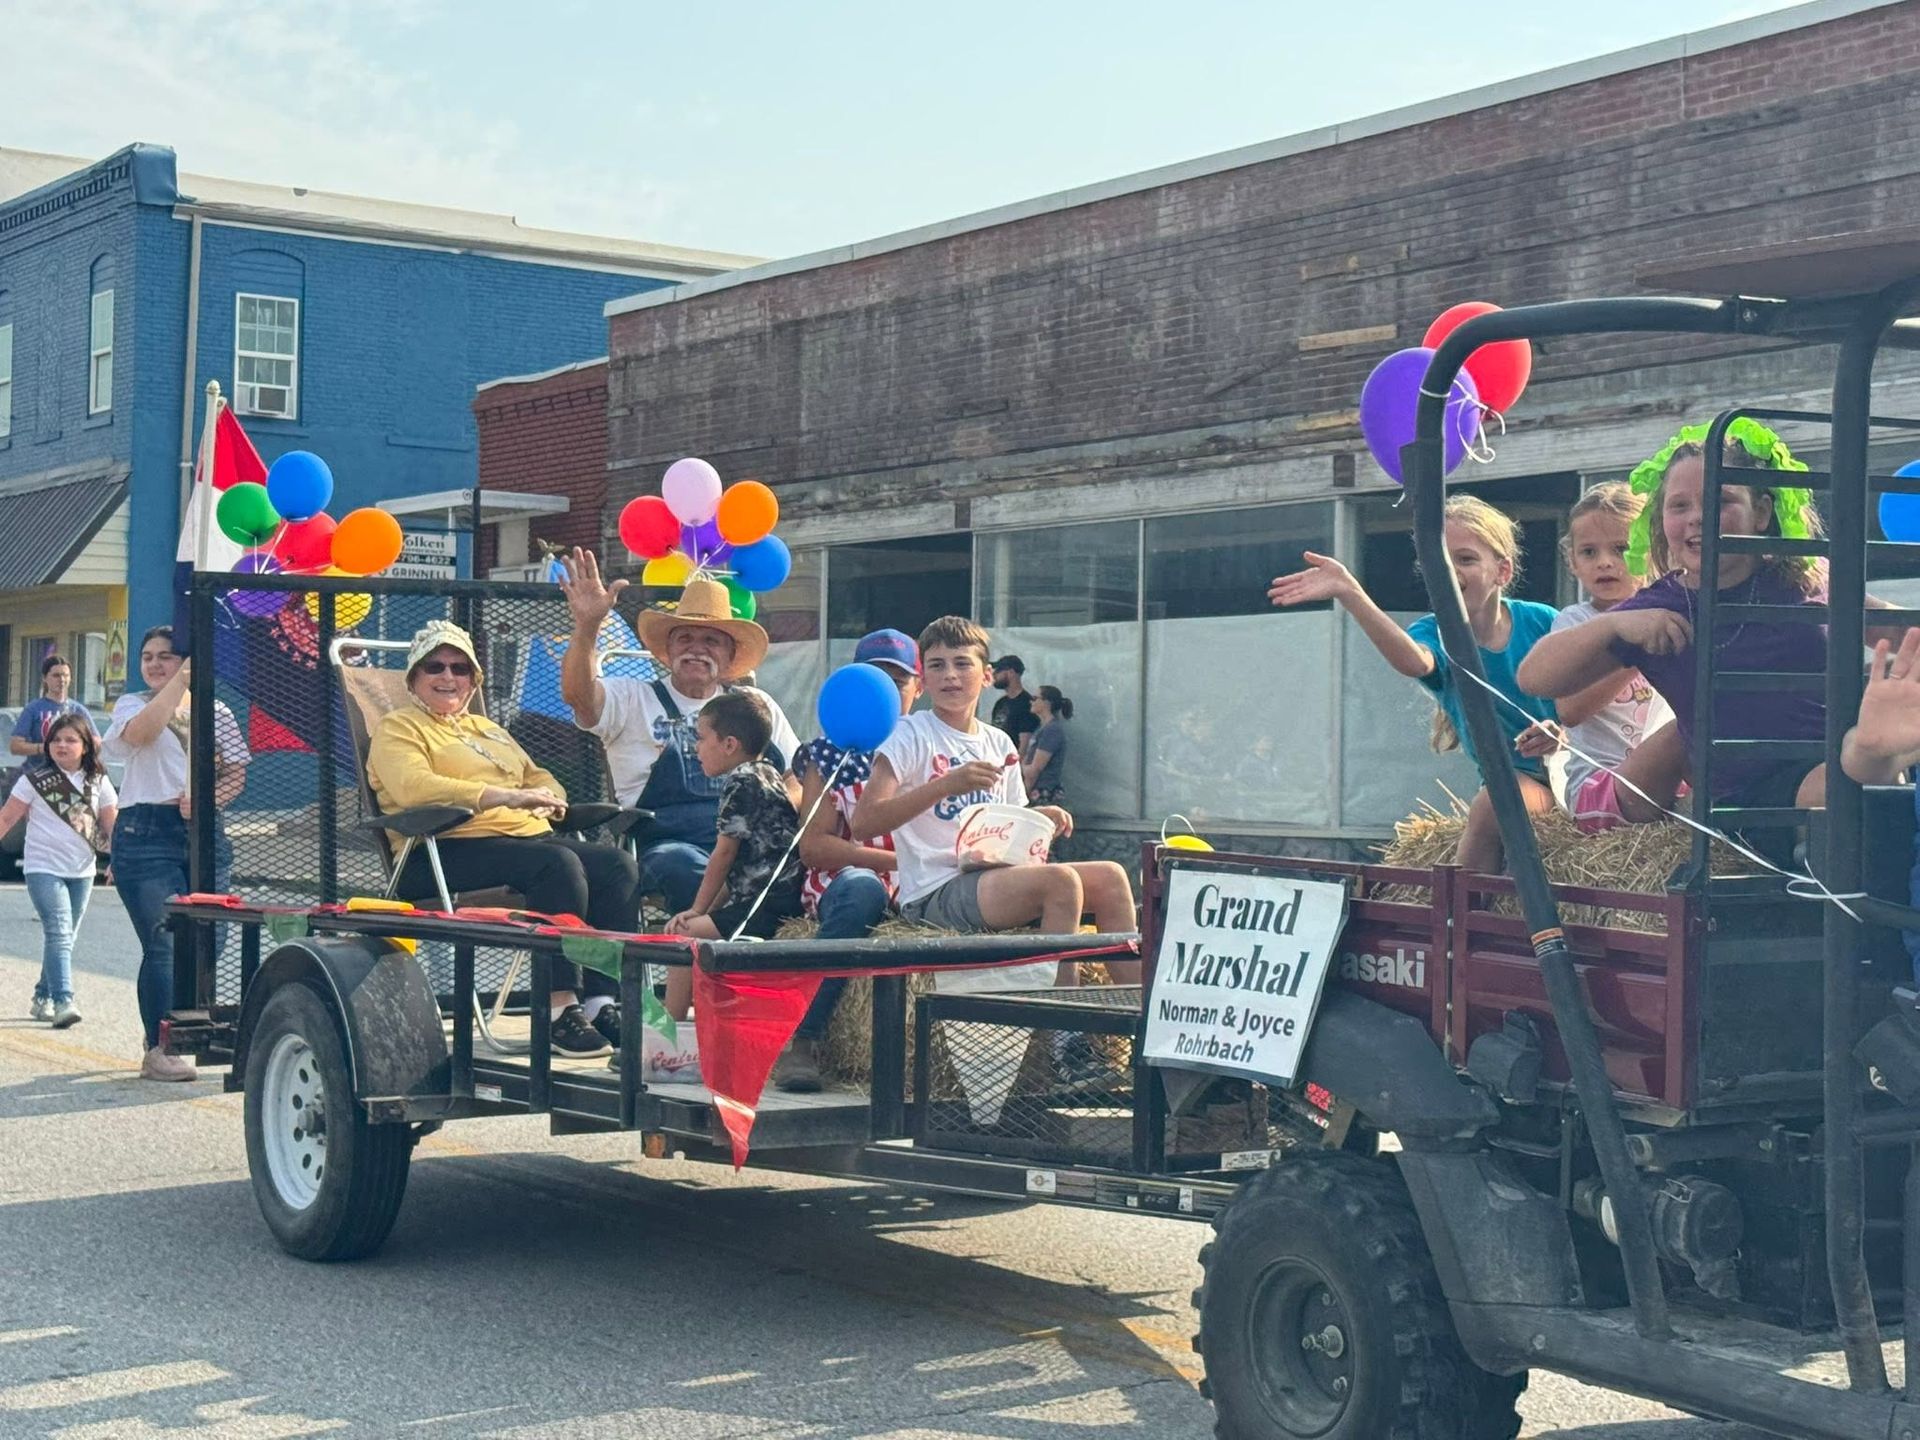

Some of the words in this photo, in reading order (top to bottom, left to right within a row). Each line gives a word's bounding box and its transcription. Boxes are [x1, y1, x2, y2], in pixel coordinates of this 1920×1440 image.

[404, 535, 445, 549] olken
[391, 567, 447, 580] GRINNELL
[1193, 884, 1304, 936] Grand
[1166, 941, 1310, 998] Marshal
[1342, 948, 1425, 988] asaki
[1159, 999, 1218, 1025] Norman
[1222, 1005, 1236, 1028] &
[1237, 1008, 1295, 1039] Joyce
[1174, 1032, 1255, 1063] Rohrbach
